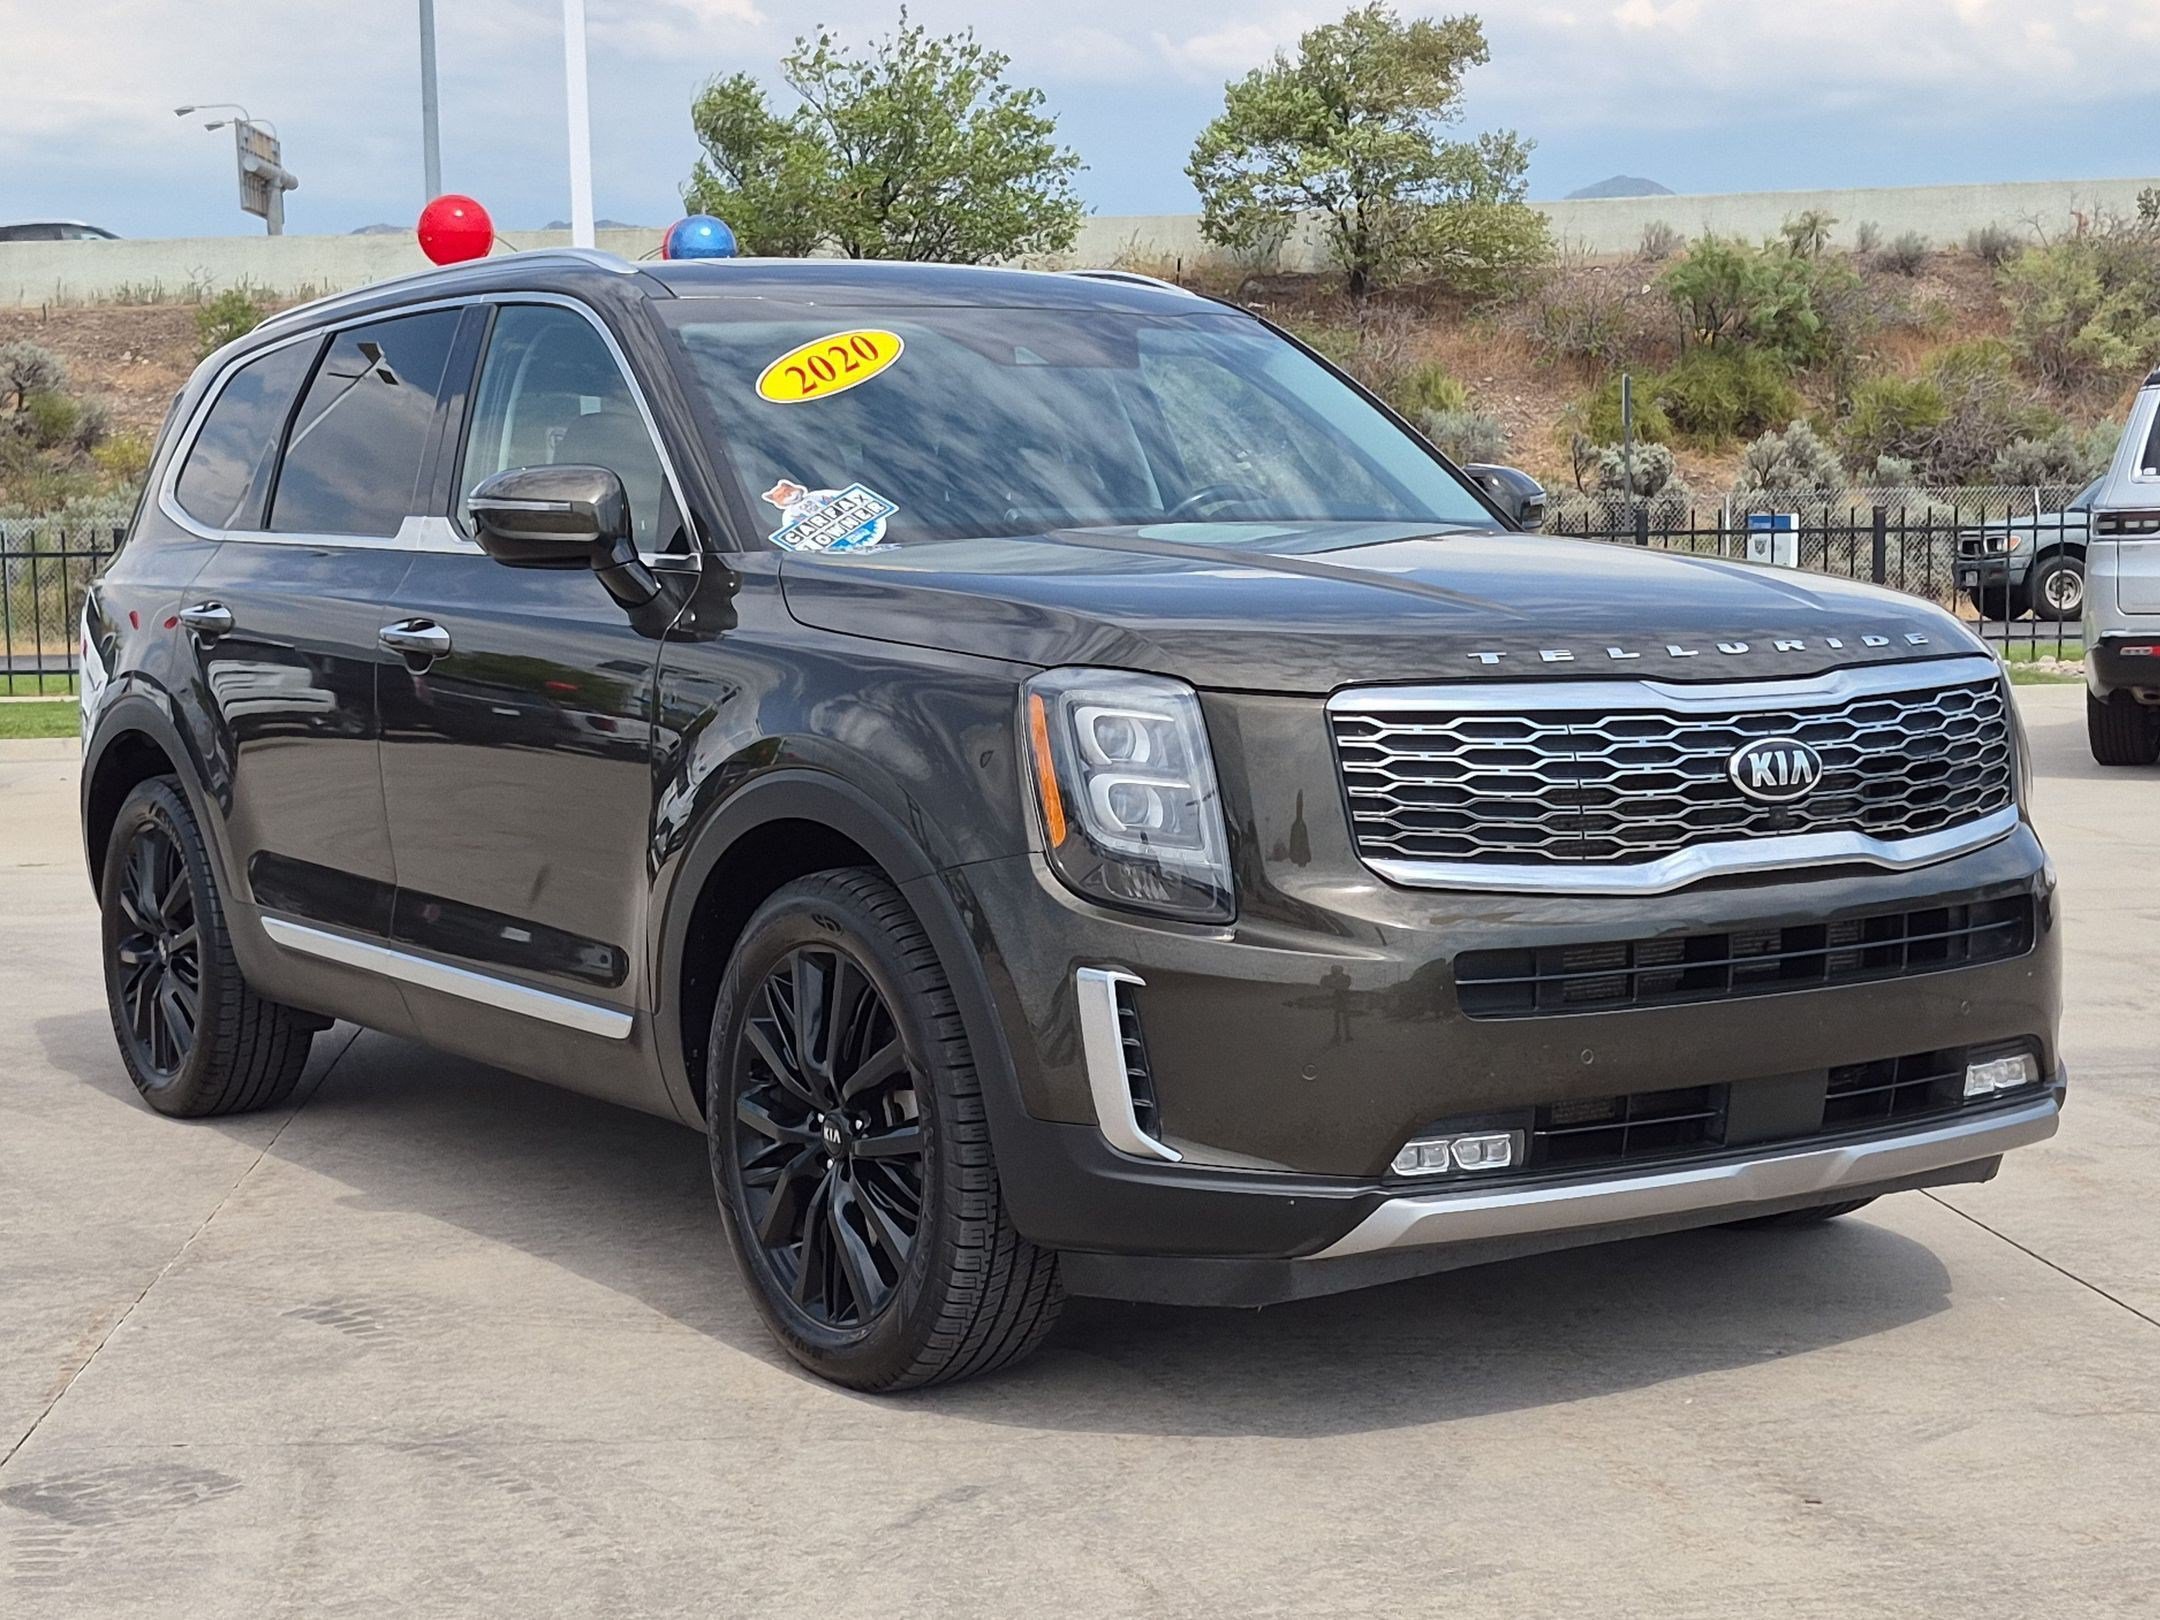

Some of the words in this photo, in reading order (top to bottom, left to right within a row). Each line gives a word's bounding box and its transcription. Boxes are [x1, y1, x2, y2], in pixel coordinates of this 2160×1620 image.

[785, 335, 879, 395] 2020
[781, 494, 869, 545] CARFAX
[811, 500, 887, 546] OWNER
[1467, 632, 1929, 665] TELLURIDE
[1748, 750, 1813, 787] KIA
[823, 1126, 841, 1144] KIA
